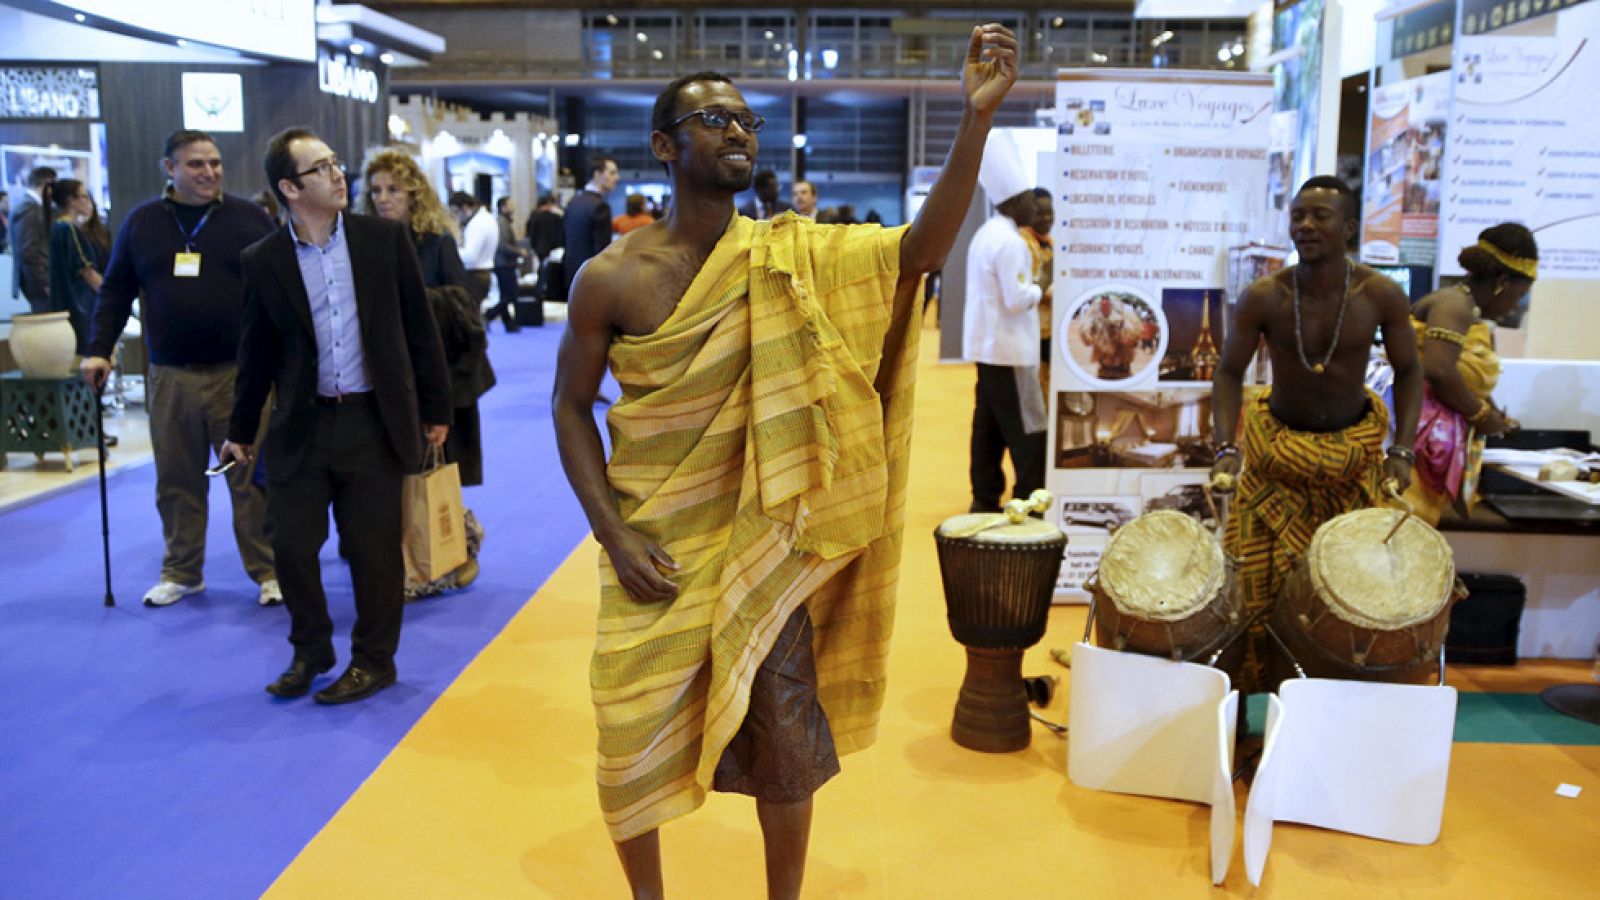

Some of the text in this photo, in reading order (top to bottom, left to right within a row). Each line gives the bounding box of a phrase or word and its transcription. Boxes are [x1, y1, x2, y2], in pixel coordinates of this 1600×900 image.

[319, 54, 379, 103] LIBANO
[9, 86, 79, 117] LIBANO
[1115, 85, 1254, 121] Luxe Voyages
[1109, 268, 1141, 279] NATIONAL
